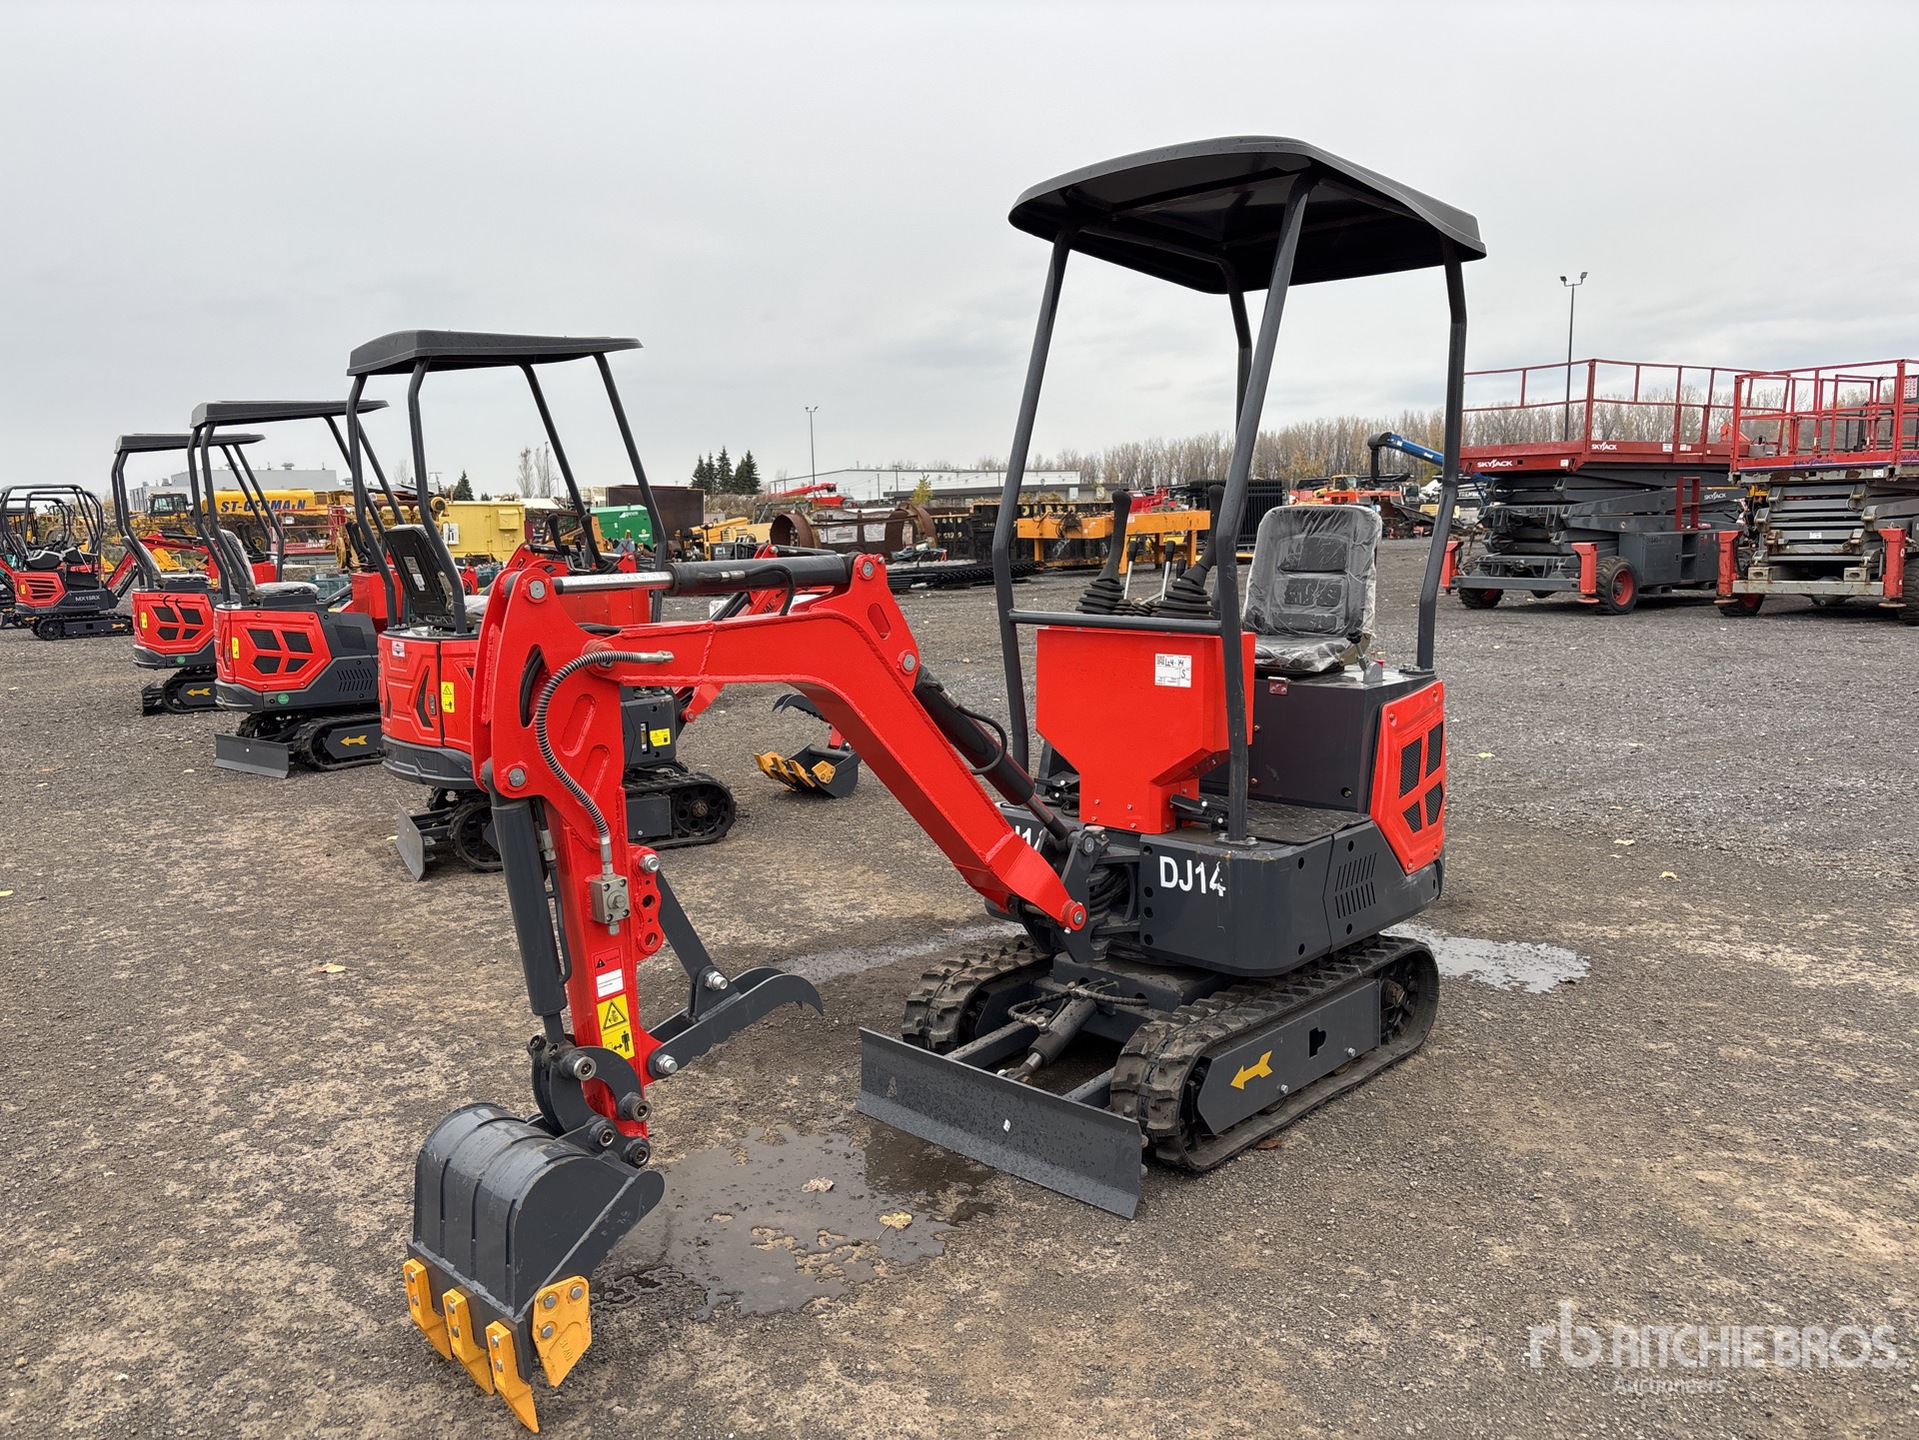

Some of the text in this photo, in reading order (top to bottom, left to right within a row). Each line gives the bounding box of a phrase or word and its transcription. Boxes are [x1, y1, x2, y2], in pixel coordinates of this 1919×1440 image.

[1591, 442, 1617, 451] SKYJACK
[1477, 459, 1513, 469] SKYJACK
[1704, 491, 1727, 500] SKYJACK
[1159, 855, 1227, 897] DJ14
